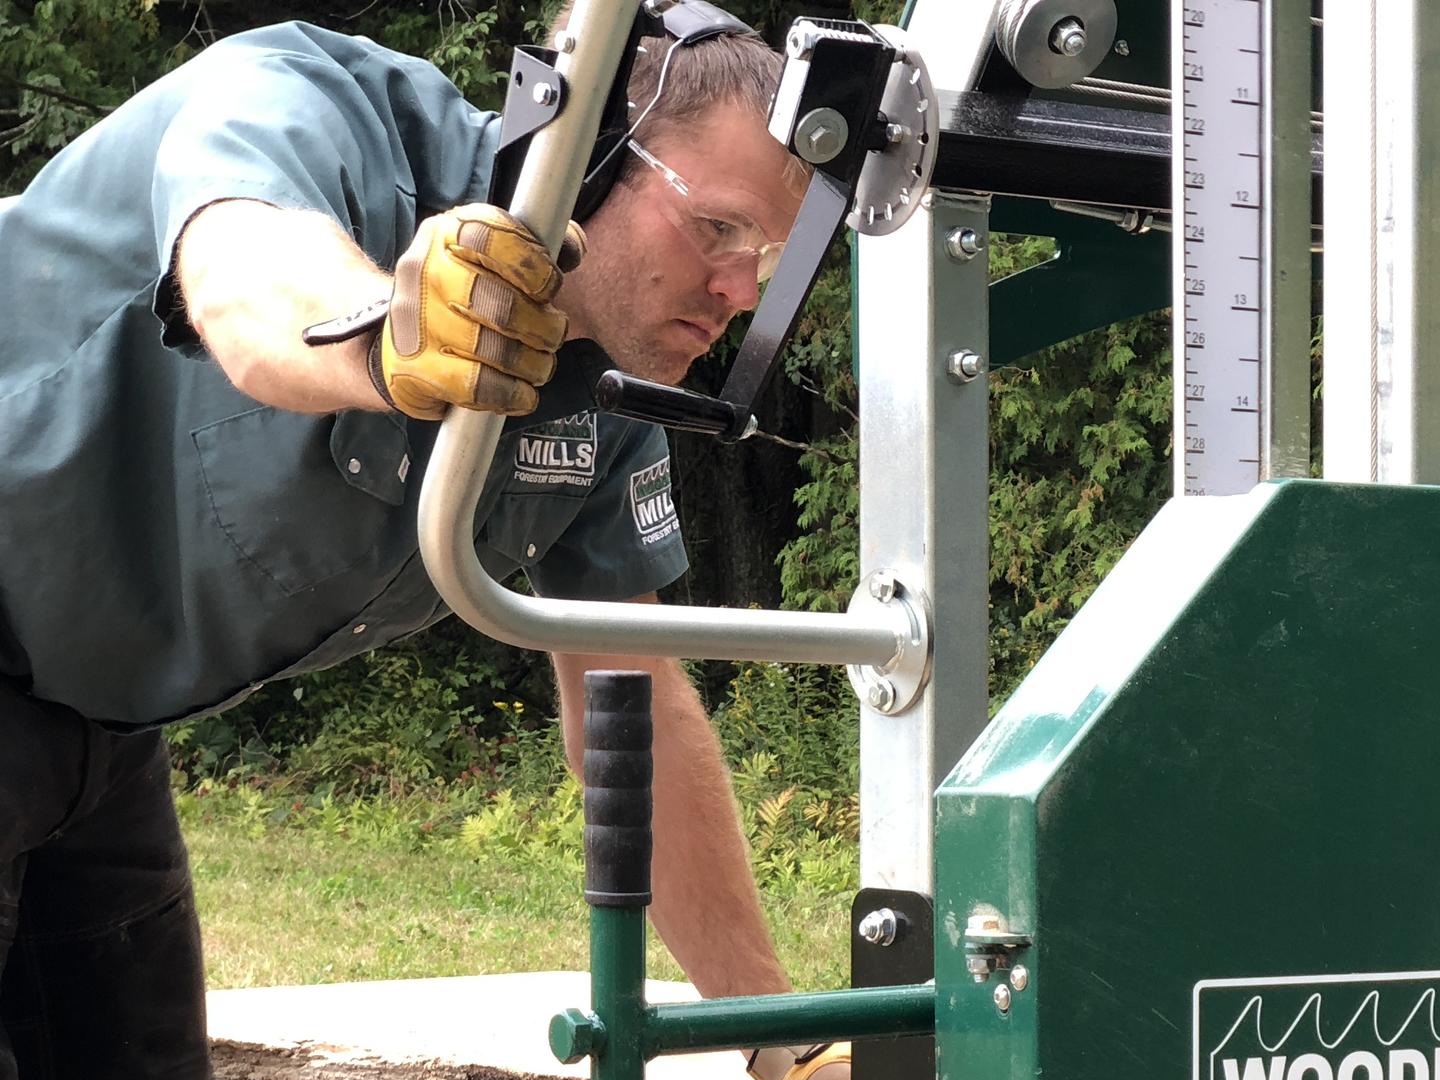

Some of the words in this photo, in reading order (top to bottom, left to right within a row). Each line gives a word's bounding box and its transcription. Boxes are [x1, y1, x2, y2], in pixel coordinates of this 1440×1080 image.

[1191, 11, 1204, 22] 20
[1191, 65, 1204, 76] 21
[1237, 88, 1249, 98] 11
[1191, 119, 1205, 130] 22
[1191, 173, 1205, 184] 23
[1236, 191, 1249, 202] 12
[1192, 226, 1204, 237] 24
[1192, 280, 1205, 291] 25
[1234, 295, 1247, 305] 13
[1192, 333, 1205, 344] 26
[1192, 385, 1205, 396] 27
[1237, 396, 1249, 407] 14
[1192, 438, 1205, 449] 28
[519, 437, 593, 468] MILLS
[637, 492, 676, 527] MIL
